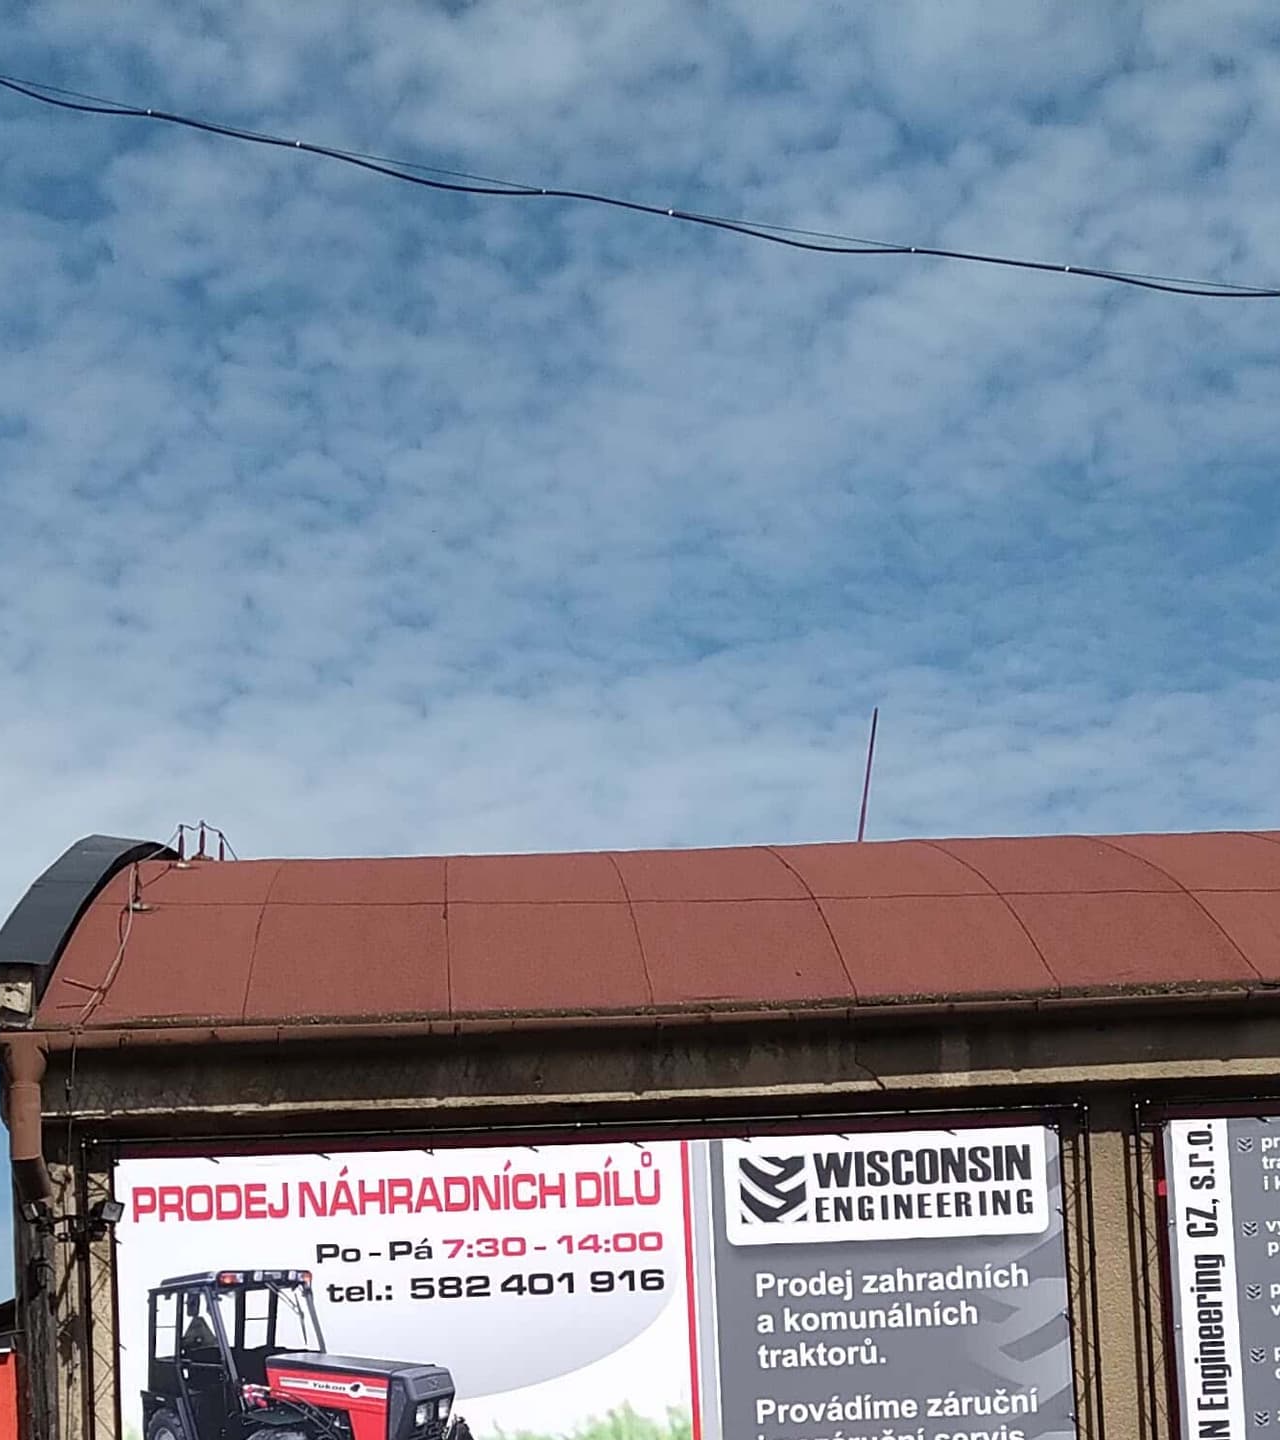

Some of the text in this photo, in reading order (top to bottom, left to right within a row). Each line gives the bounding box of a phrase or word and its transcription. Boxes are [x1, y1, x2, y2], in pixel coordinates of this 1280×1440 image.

[813, 1144, 1032, 1189] WISCONSIN
[1187, 1123, 1215, 1190] s.r.o.
[132, 1151, 662, 1223] PRODEJ NÁHRADNÍCH DÍLŮ
[1263, 1175, 1269, 1190] i
[815, 1188, 1033, 1223] ENGINEERING
[1186, 1198, 1220, 1238] CZ,
[316, 1243, 361, 1264] Po
[389, 1238, 433, 1261] Pá
[442, 1236, 527, 1259] 7:30
[556, 1231, 664, 1255] 14:00
[327, 1269, 665, 1303] tel.: 582 401 916
[756, 1263, 1030, 1301] Prodej zahradních
[756, 1300, 978, 1334] a komunálních
[1190, 1254, 1232, 1410] Engineering
[758, 1337, 887, 1369] traktorů.
[756, 1388, 1039, 1424] Provádíme záruční
